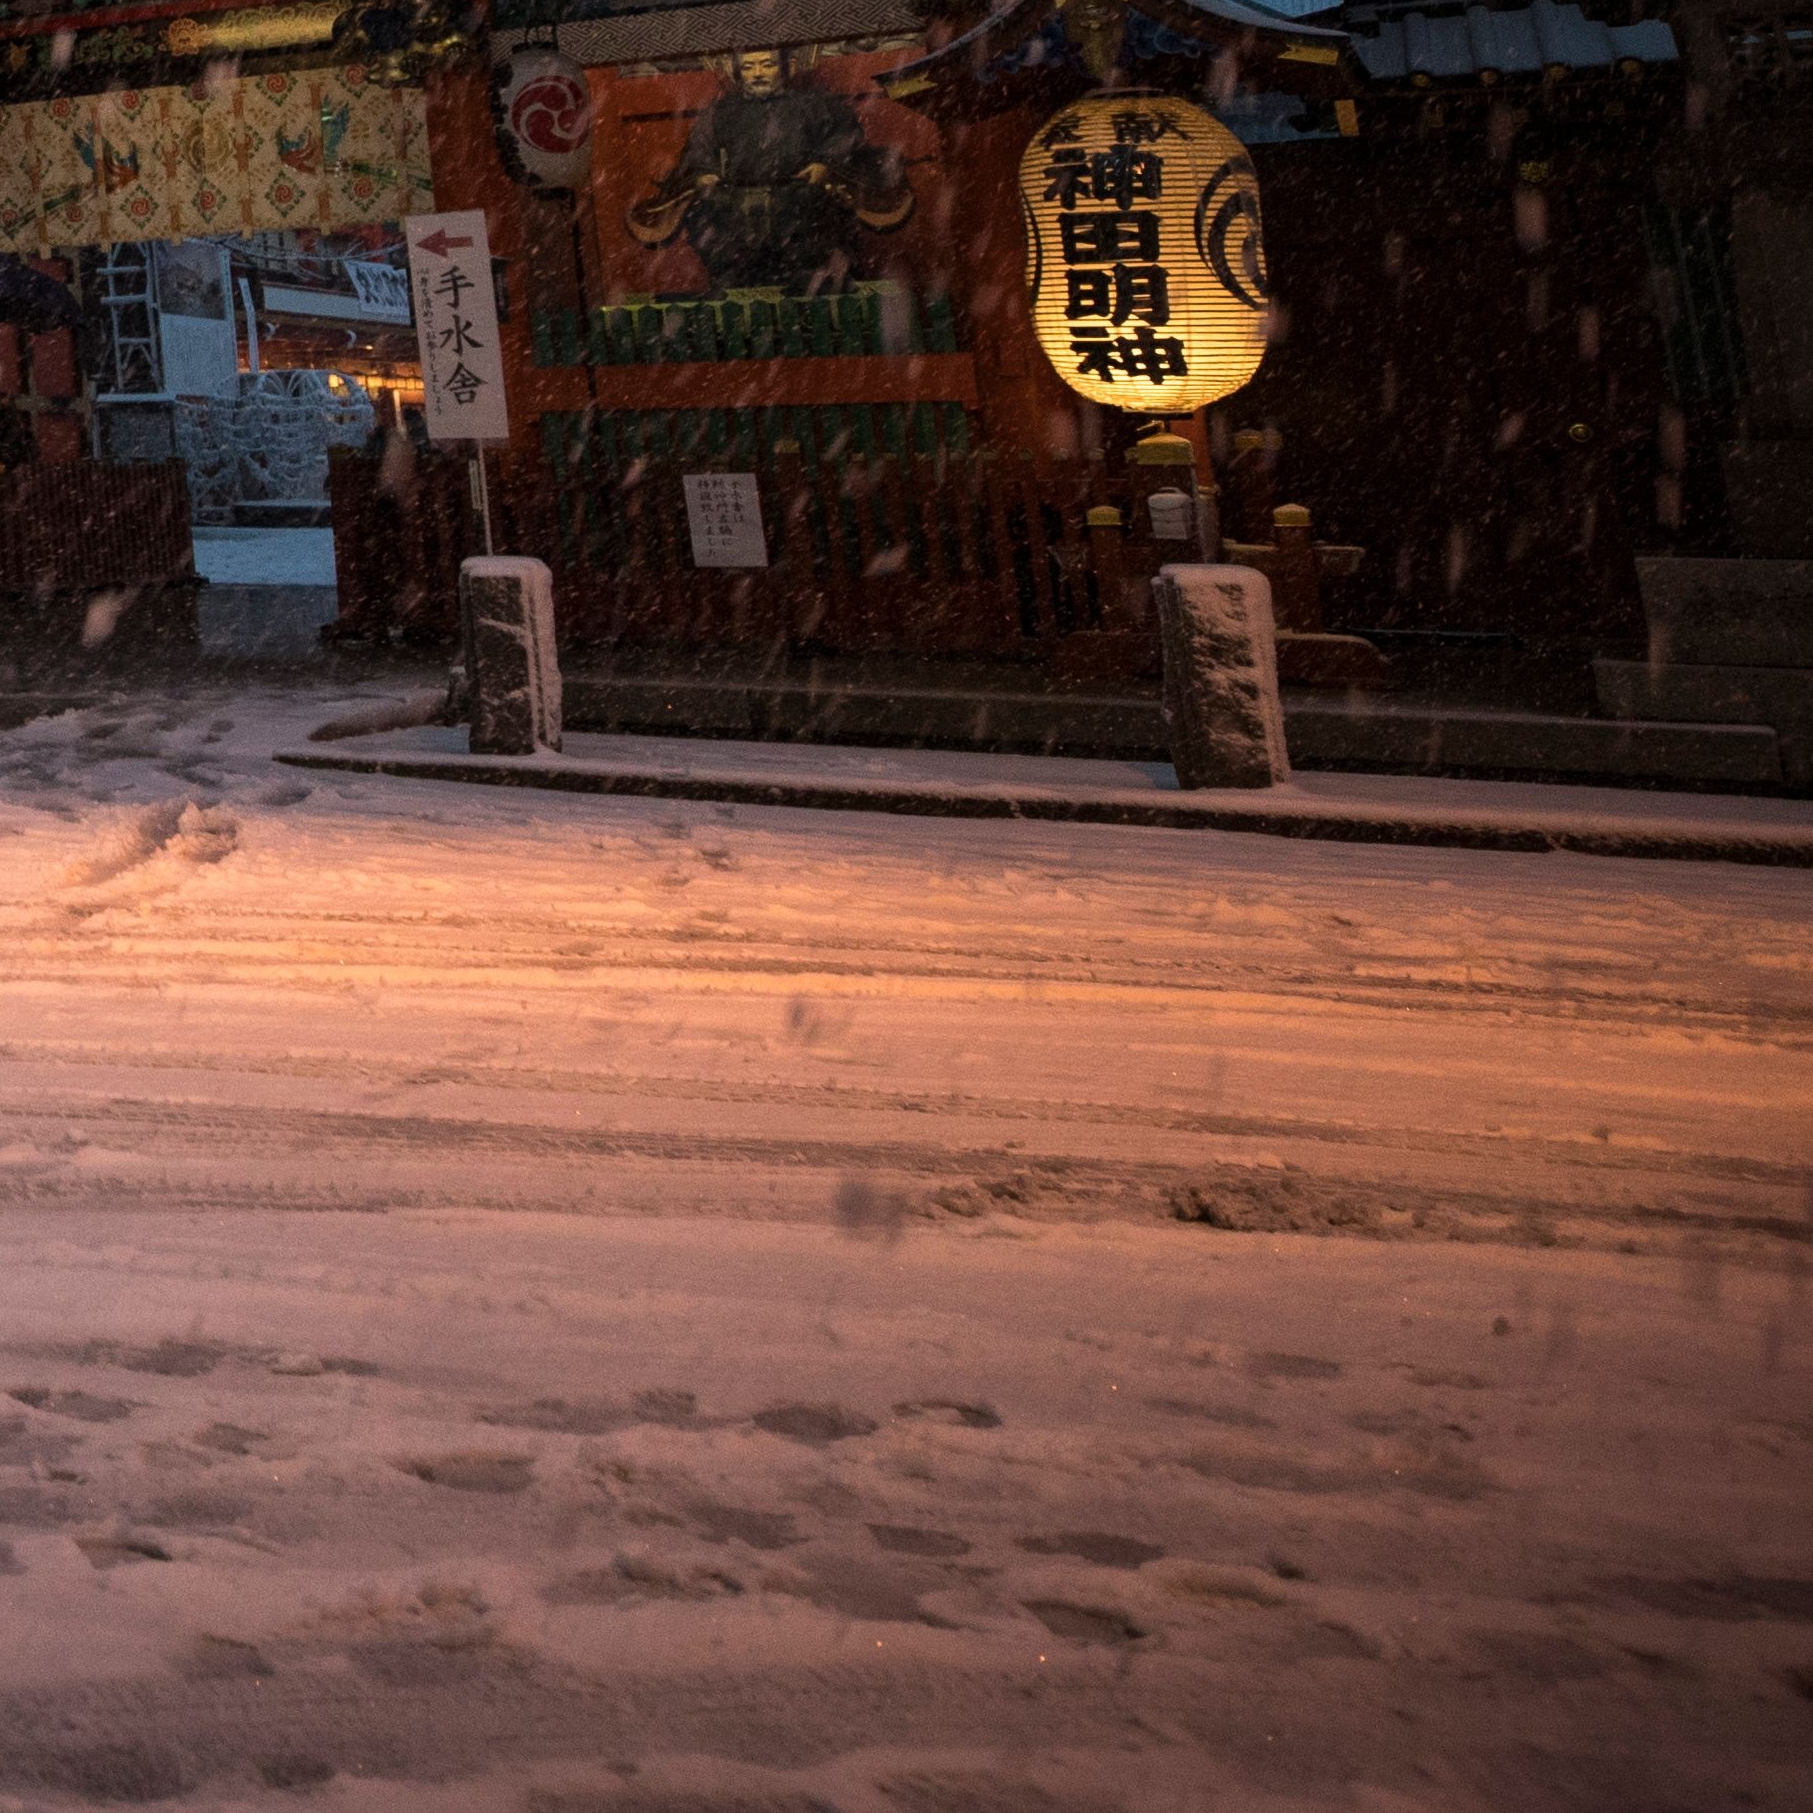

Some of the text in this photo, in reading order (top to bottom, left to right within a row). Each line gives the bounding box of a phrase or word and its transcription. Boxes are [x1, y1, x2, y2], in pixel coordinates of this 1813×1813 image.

[434, 265, 488, 405] 手水舎
[1043, 143, 1188, 385] 神田明神
